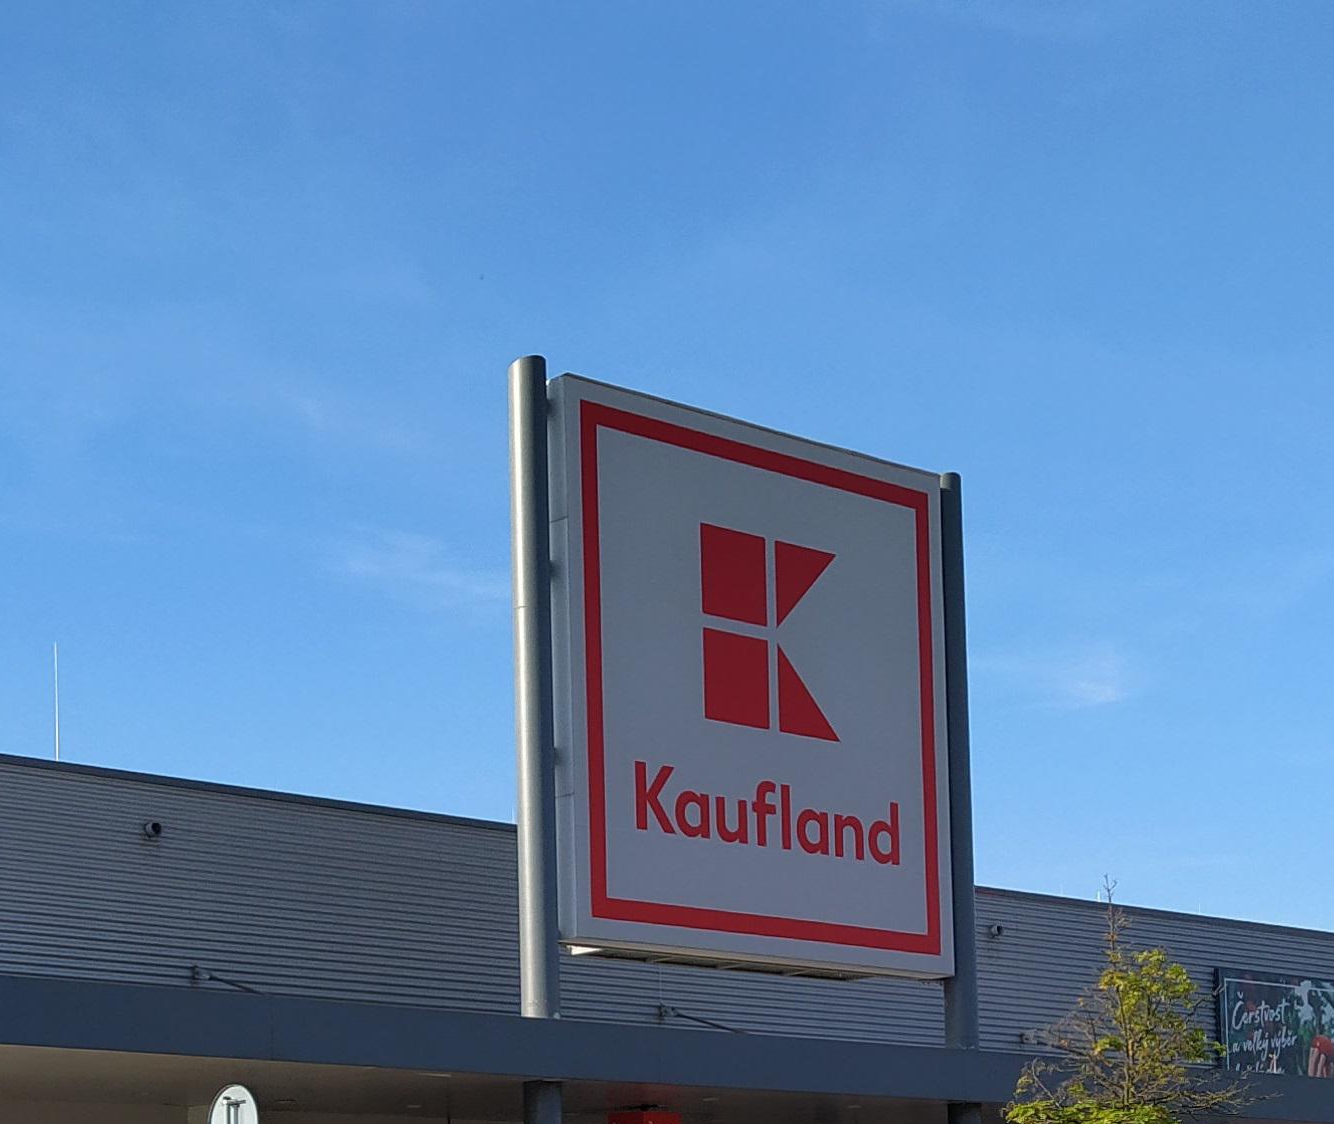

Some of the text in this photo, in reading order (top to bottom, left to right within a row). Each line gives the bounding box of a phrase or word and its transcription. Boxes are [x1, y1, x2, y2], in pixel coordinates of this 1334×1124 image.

[634, 760, 900, 866] Kaufland
[1232, 991, 1290, 1030] Čerstvost
[1232, 1025, 1297, 1062] a velký výběr
